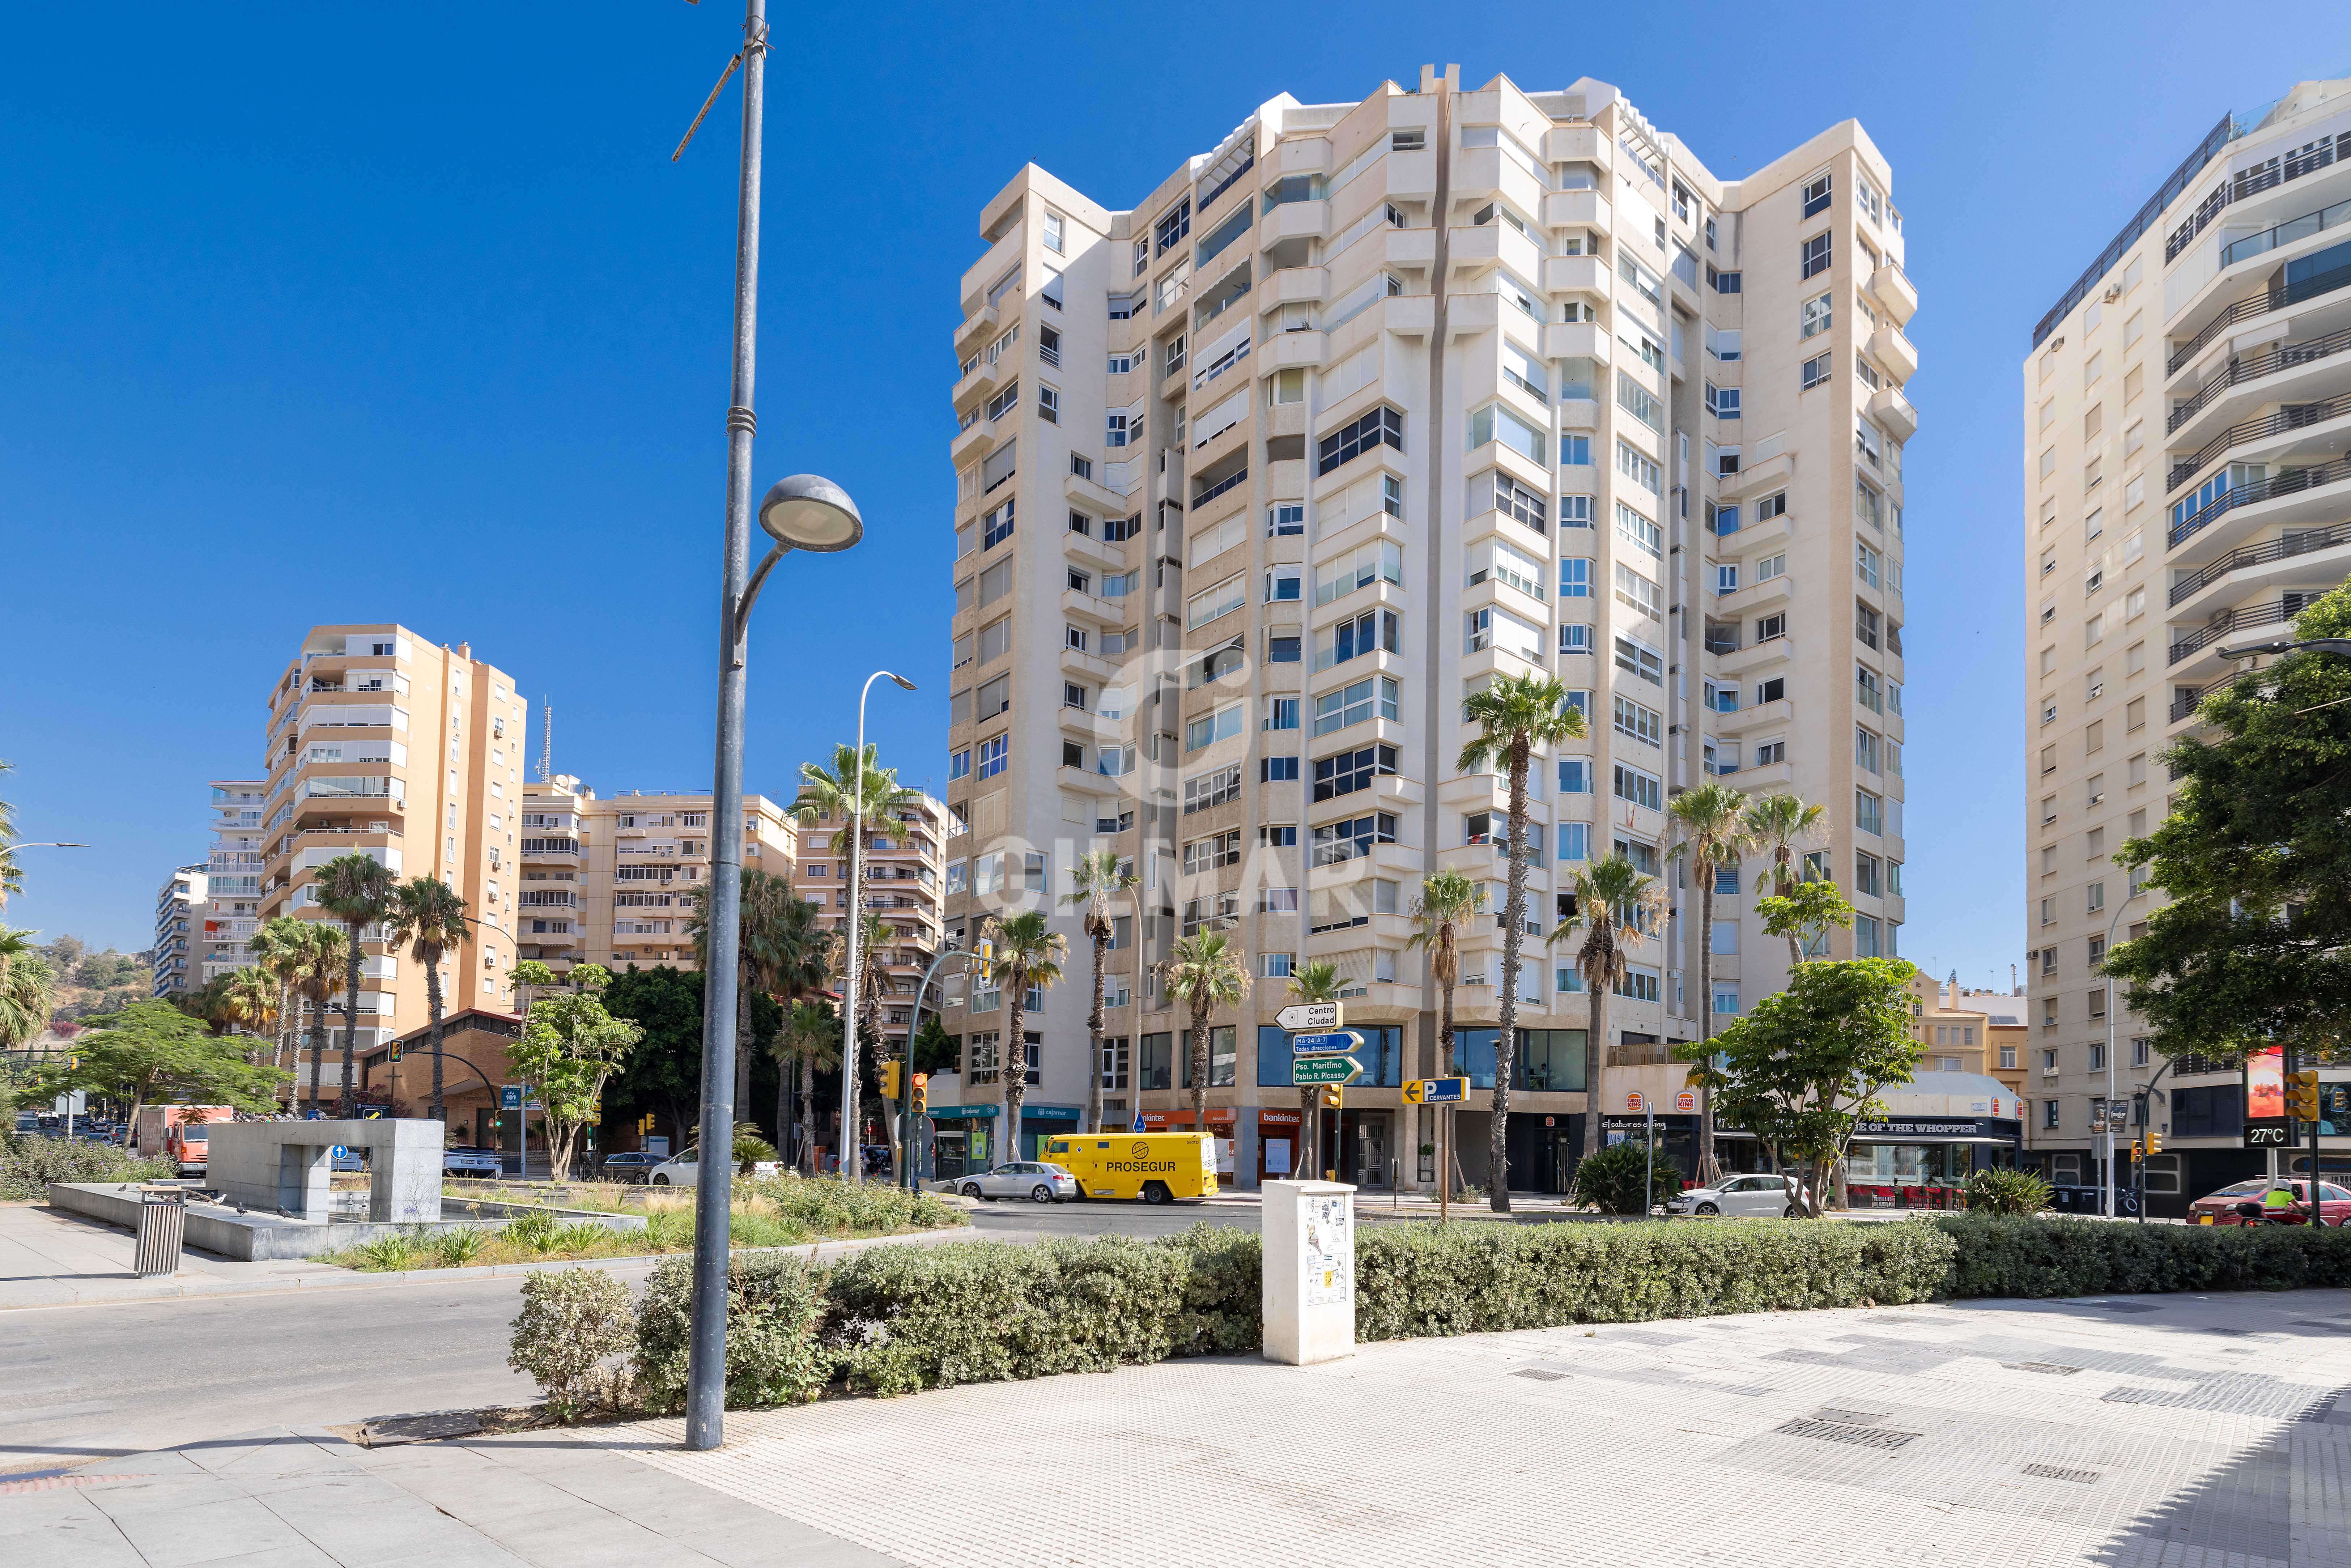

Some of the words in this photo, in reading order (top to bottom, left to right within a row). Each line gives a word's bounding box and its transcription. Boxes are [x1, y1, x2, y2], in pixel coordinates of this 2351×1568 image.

[1309, 1006, 1334, 1015] Centro
[1308, 1016, 1334, 1025] Ciudad
[1424, 1082, 1437, 1101] P
[1652, 1119, 1666, 1131] ing
[1869, 1123, 1885, 1131] OF
[1887, 1123, 1913, 1132] THE
[1914, 1124, 1977, 1133] WHOPPER
[1106, 1161, 1176, 1172] PROSEGUR
